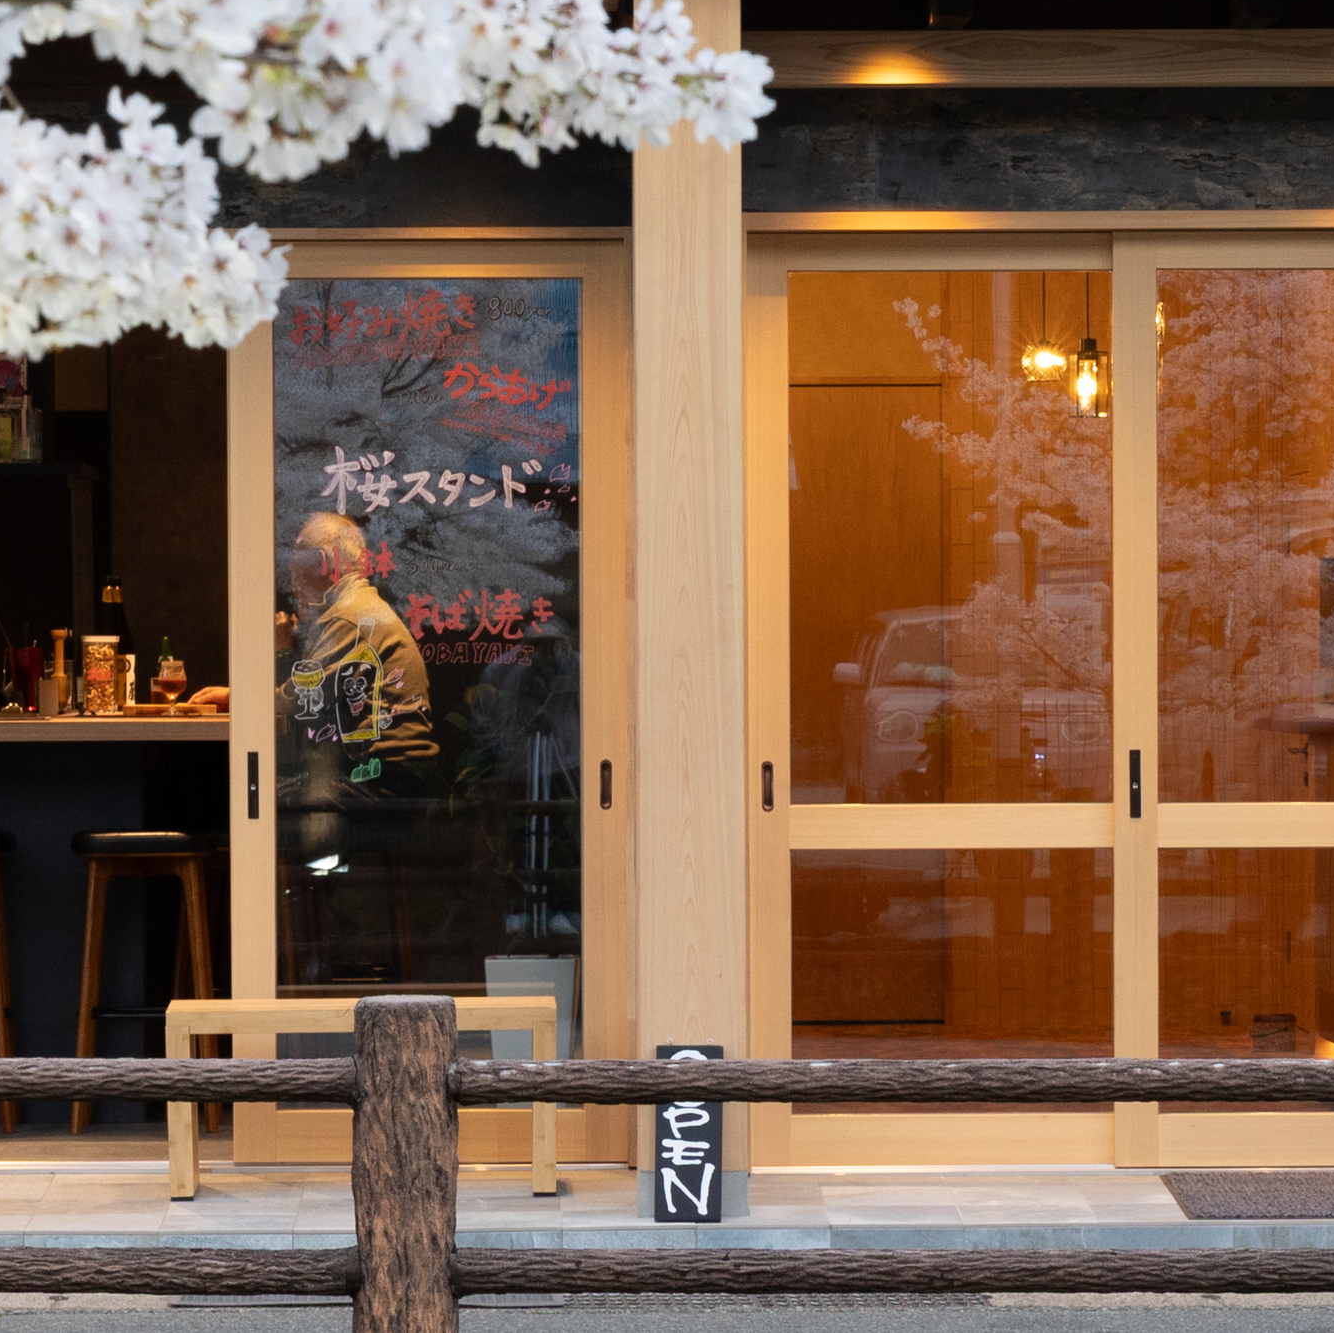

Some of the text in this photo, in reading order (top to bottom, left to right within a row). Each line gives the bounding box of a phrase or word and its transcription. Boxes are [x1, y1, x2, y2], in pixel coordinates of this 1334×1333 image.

[289, 288, 478, 345] お好み焼き
[443, 362, 571, 411] からあげ
[321, 446, 542, 515] 桜スタンド
[321, 541, 397, 584] 小鉢
[404, 589, 554, 640] そば焼き
[415, 641, 535, 666] OBAYAKI
[661, 1050, 715, 1216] PEN
